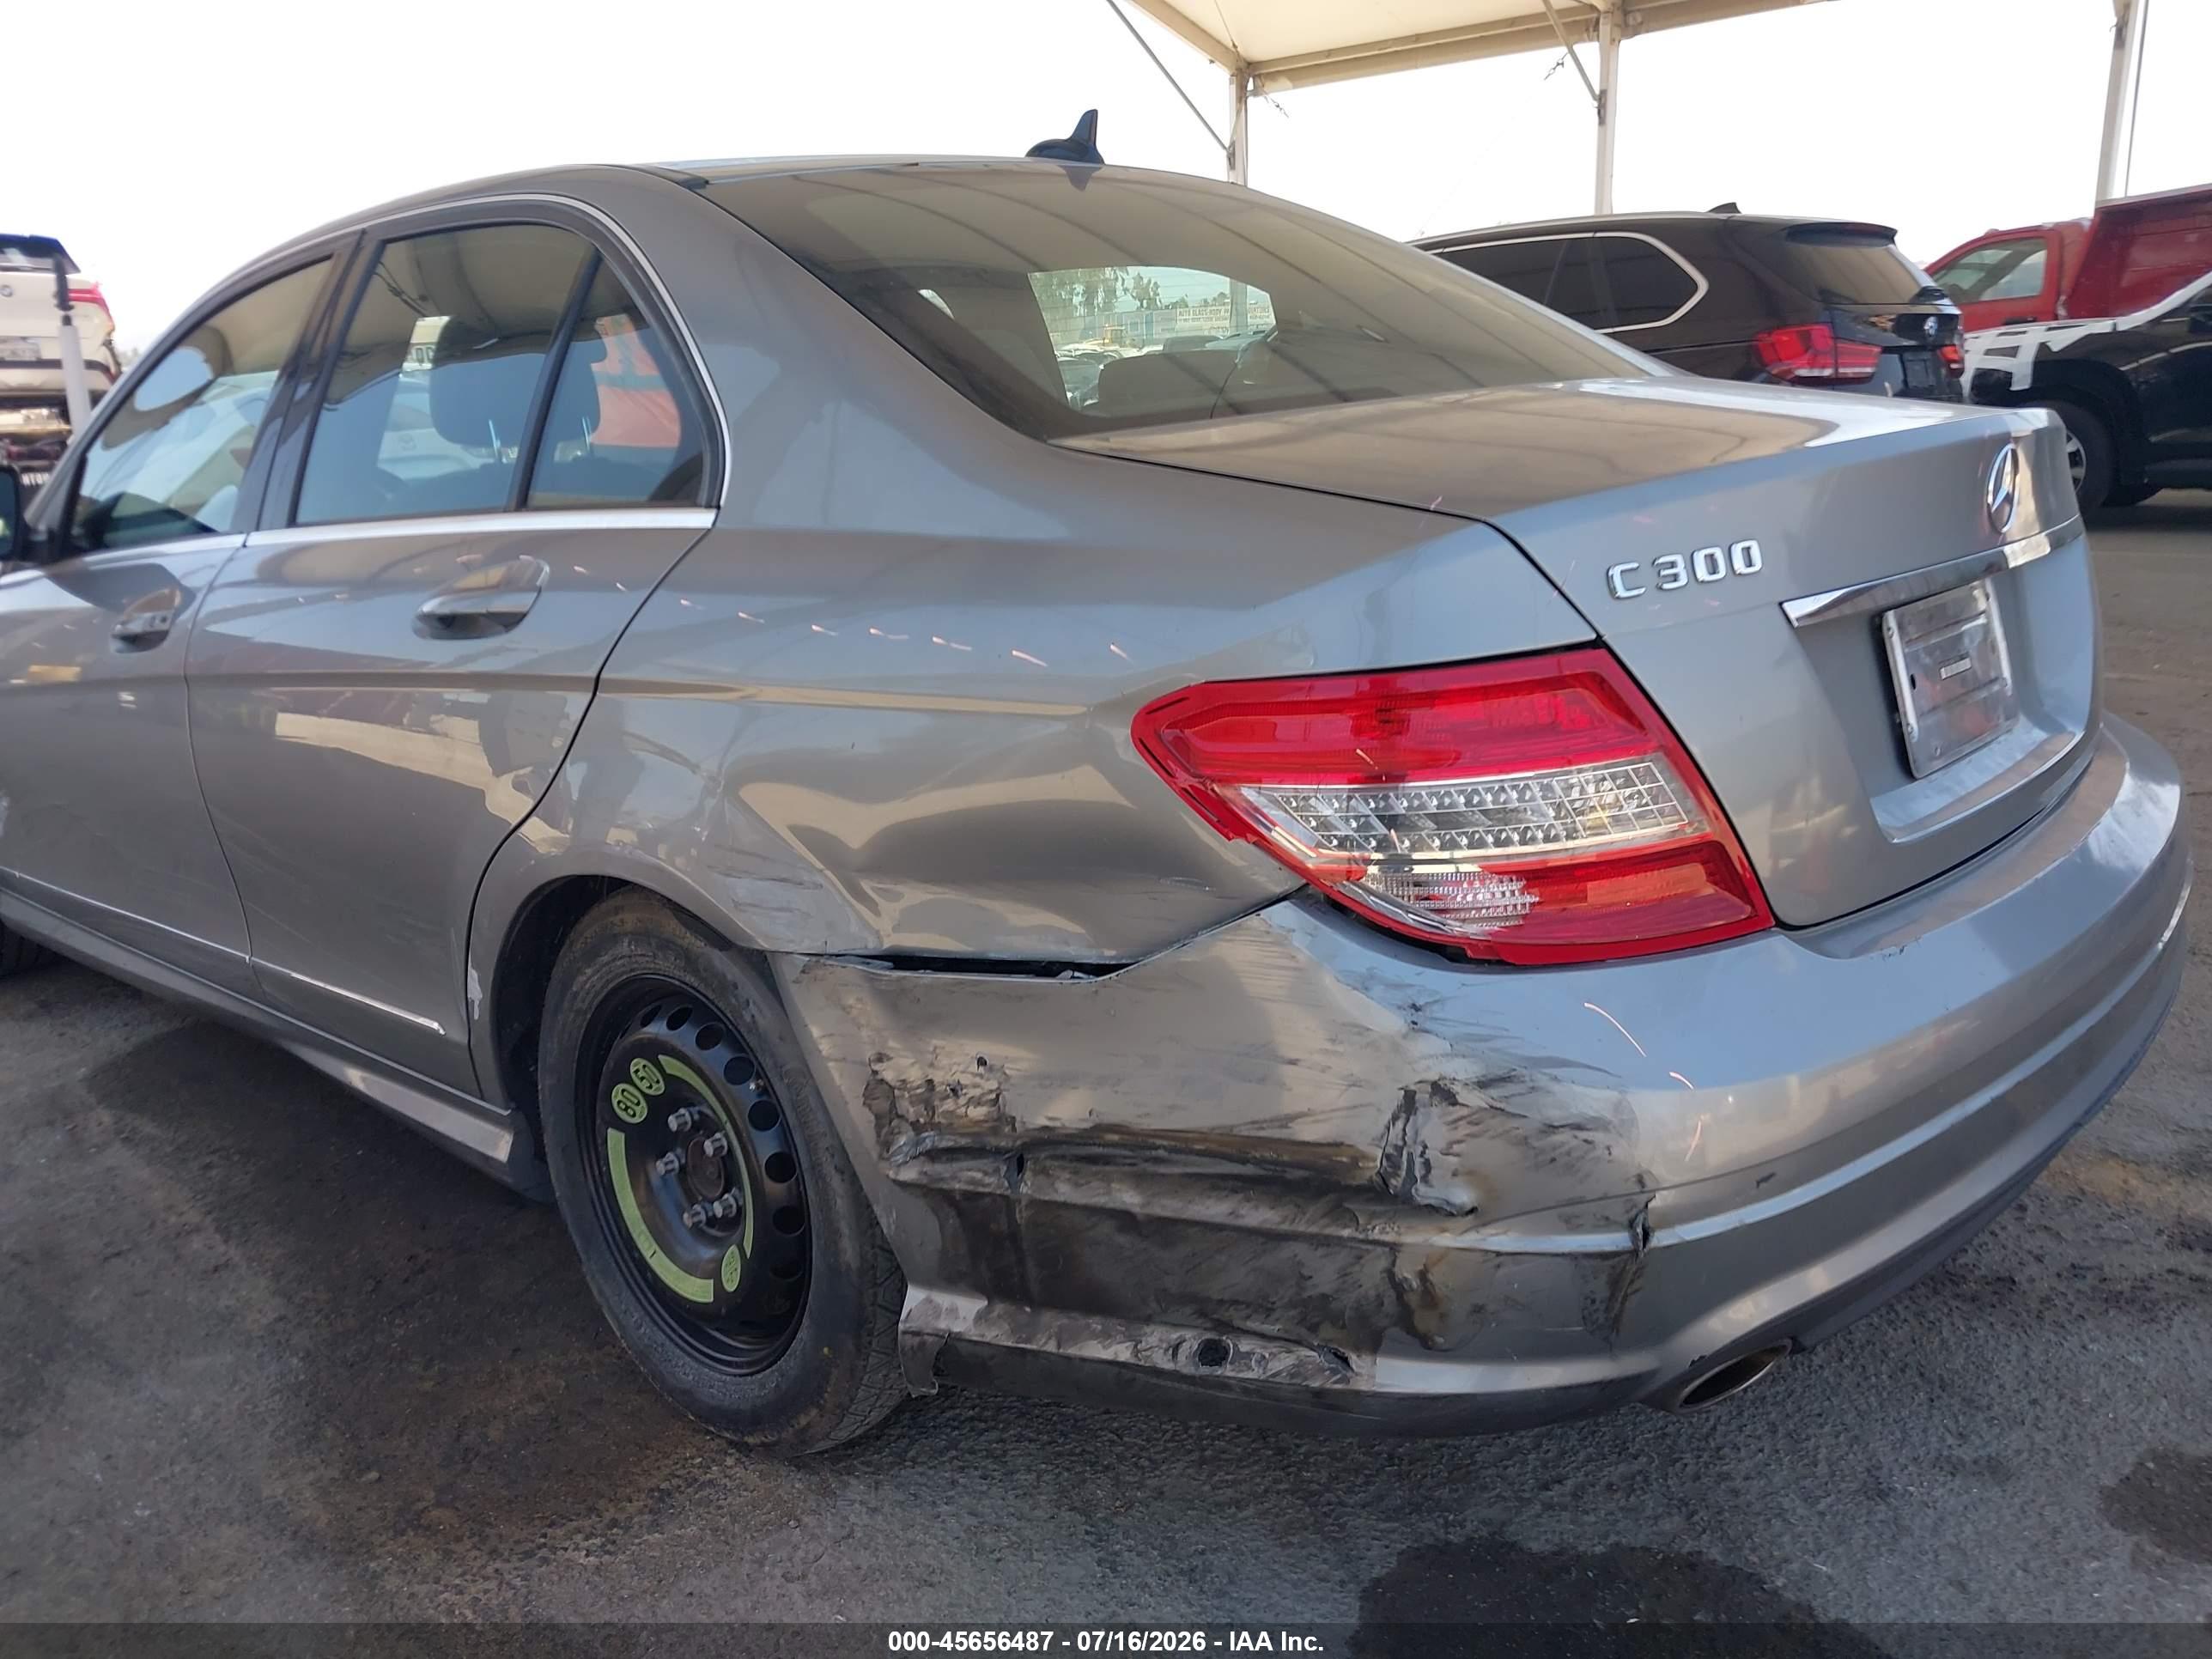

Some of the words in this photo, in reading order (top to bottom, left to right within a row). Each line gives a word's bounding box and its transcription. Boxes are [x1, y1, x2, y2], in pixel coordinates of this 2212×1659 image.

[1607, 562, 1647, 599] C
[1652, 538, 1763, 591] 300
[633, 1064, 660, 1090] 50
[617, 1088, 641, 1118] 80
